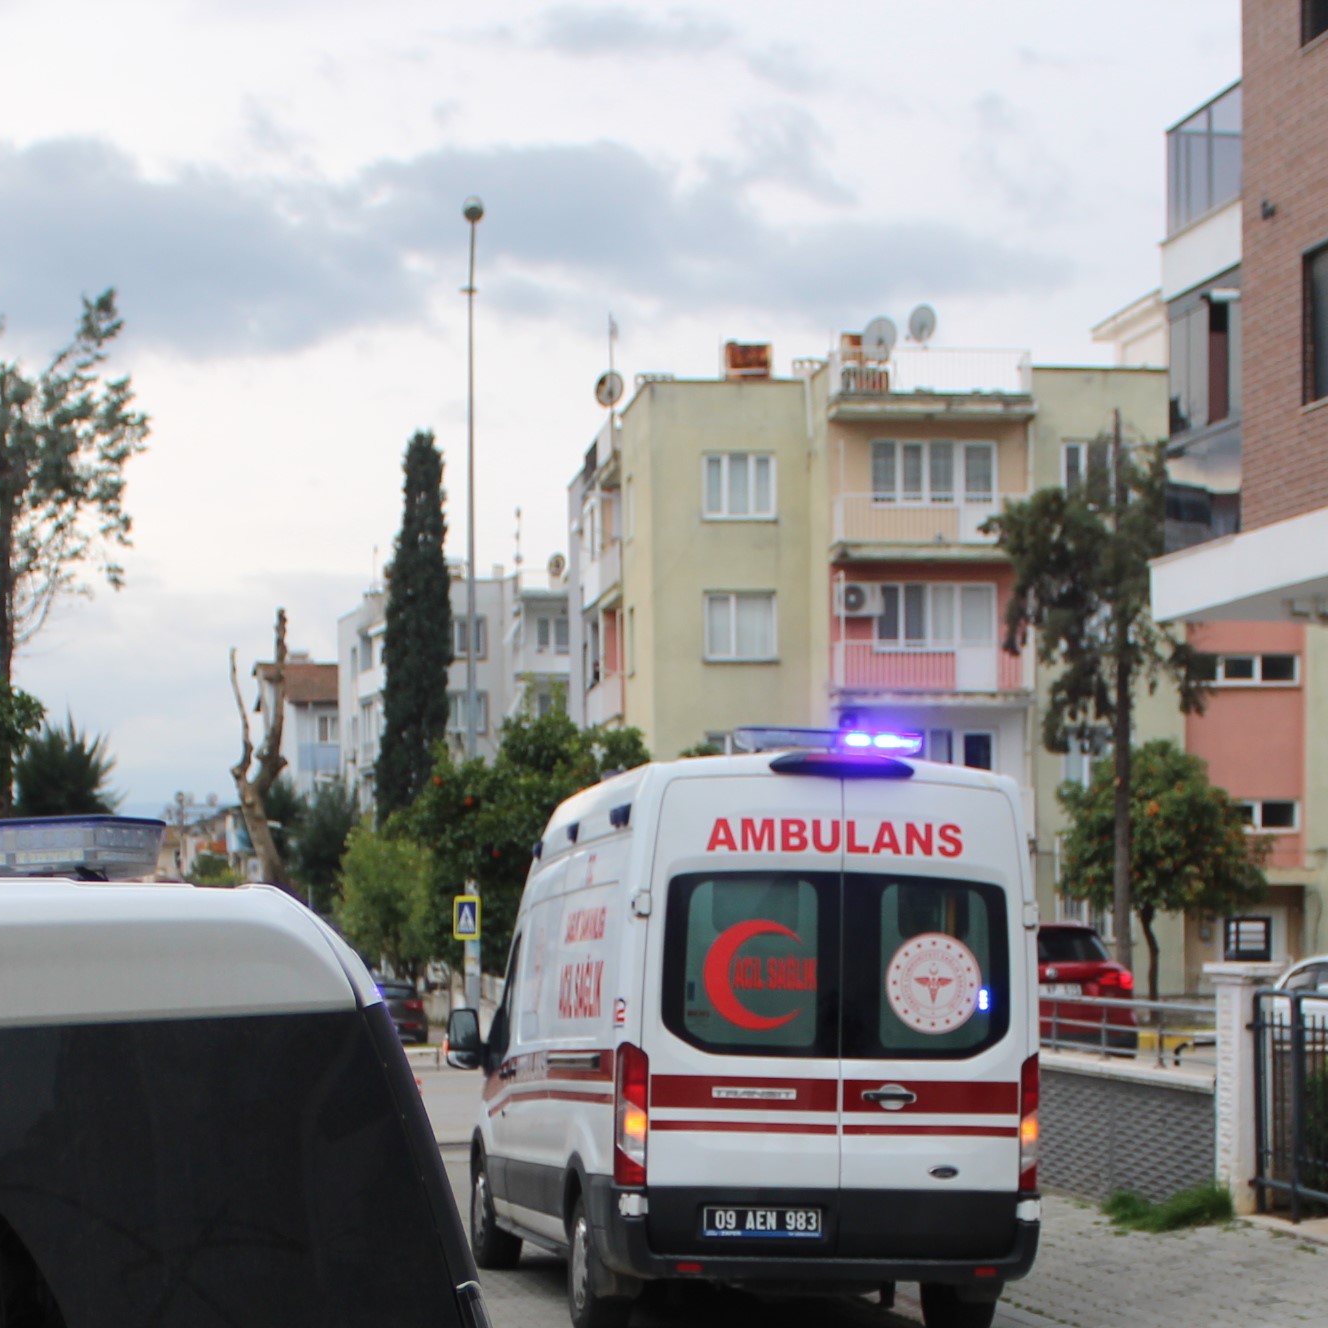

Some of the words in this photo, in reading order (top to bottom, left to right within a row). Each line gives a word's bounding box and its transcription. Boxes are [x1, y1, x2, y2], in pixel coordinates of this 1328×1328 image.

[706, 817, 964, 859] AMBULANS
[715, 1210, 737, 1230] 09
[745, 1210, 777, 1231] AEN
[785, 1211, 818, 1231] 983
